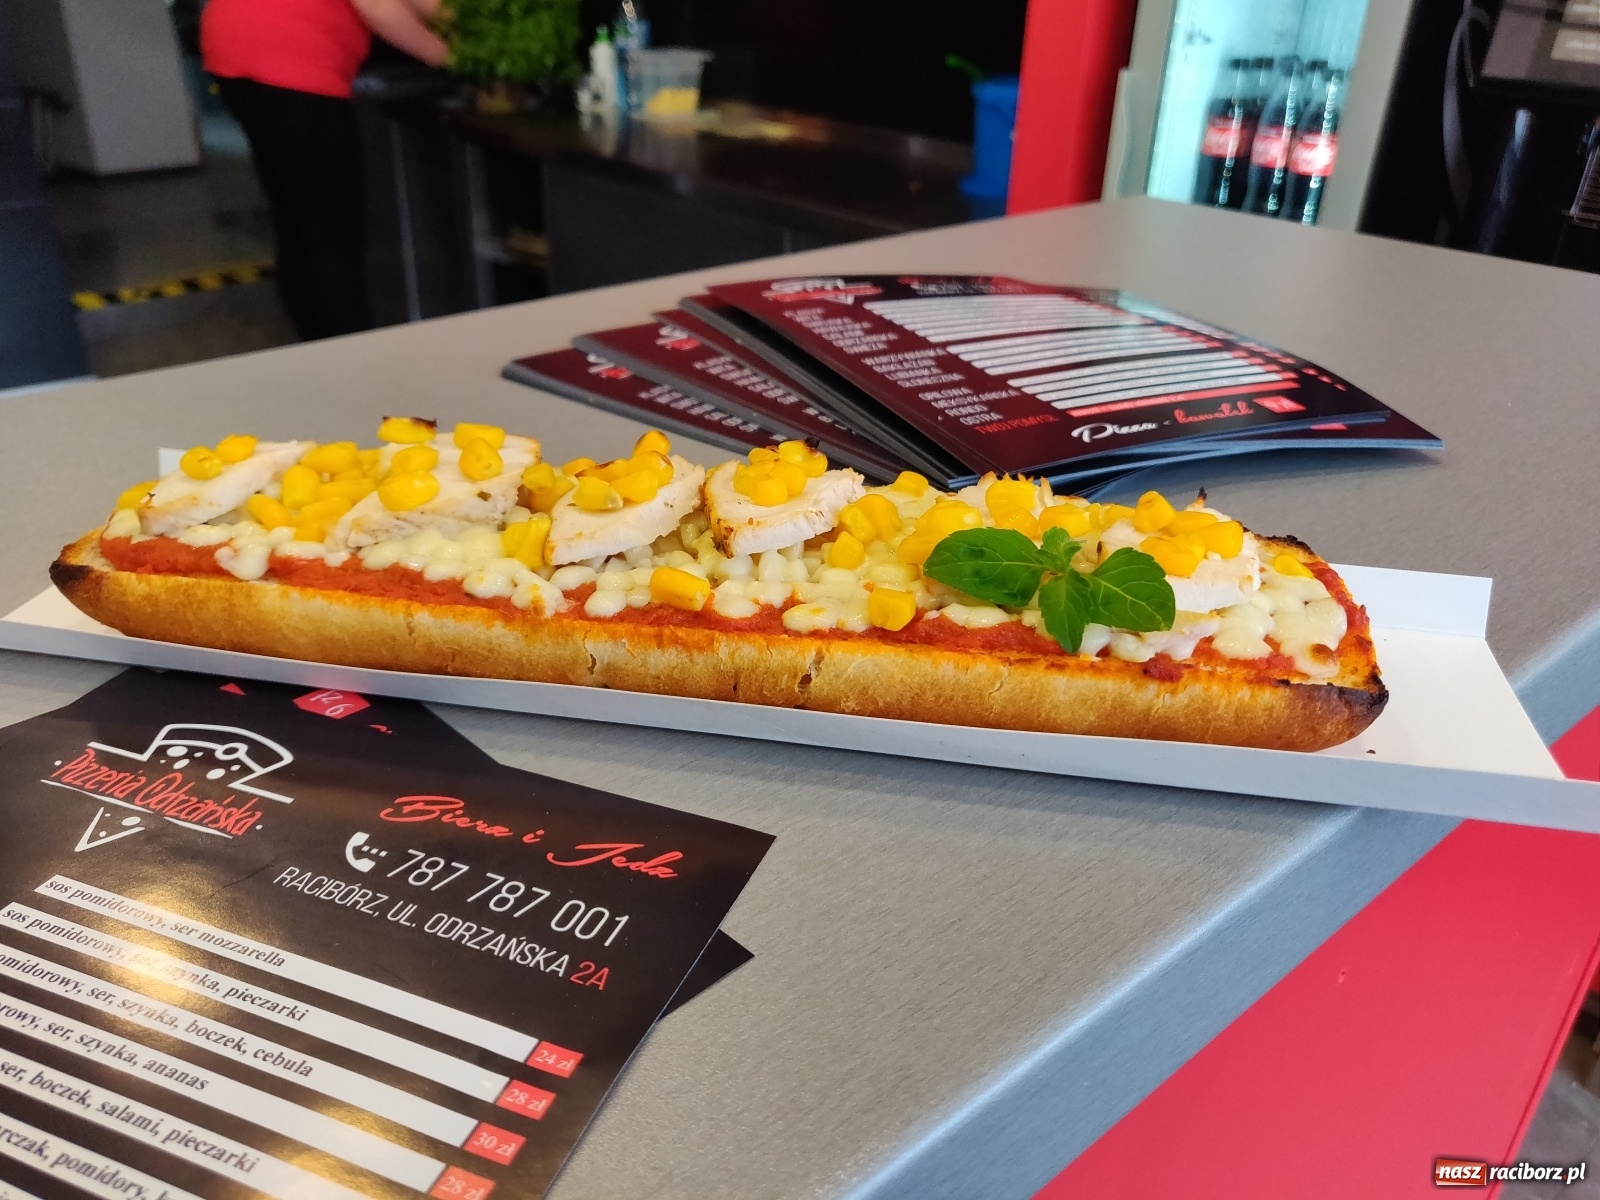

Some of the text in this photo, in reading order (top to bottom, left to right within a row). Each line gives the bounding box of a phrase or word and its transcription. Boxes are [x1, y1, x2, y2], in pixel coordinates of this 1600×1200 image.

[51, 748, 263, 836] Pizzeria Odrzańska
[522, 829, 545, 845] i
[45, 879, 286, 968] sos pomidorowy, ser mozzarella
[273, 866, 611, 991] RACIBÓRZ, UL. ODRZAŃSKA 2A
[387, 849, 630, 947] 787 787 001
[2, 908, 28, 923] sos
[28, 917, 125, 960] pomidorowy,
[160, 964, 220, 993] szynka,
[222, 983, 310, 1022] pieczarki
[0, 1003, 209, 1091] rowy, ser, szynka, ananas
[86, 987, 116, 1006] ser,
[117, 997, 179, 1029] szynka,
[184, 1016, 248, 1055] boczek,
[252, 1047, 314, 1078] cebula
[534, 1049, 576, 1071] 24 zł
[0, 1061, 260, 1173] ser, boczek, salami, pieczarki
[0, 1126, 51, 1161] rczak,
[505, 1088, 547, 1112] 28 zł
[440, 1176, 462, 1195] 28
[472, 1132, 517, 1157] 30 zł
